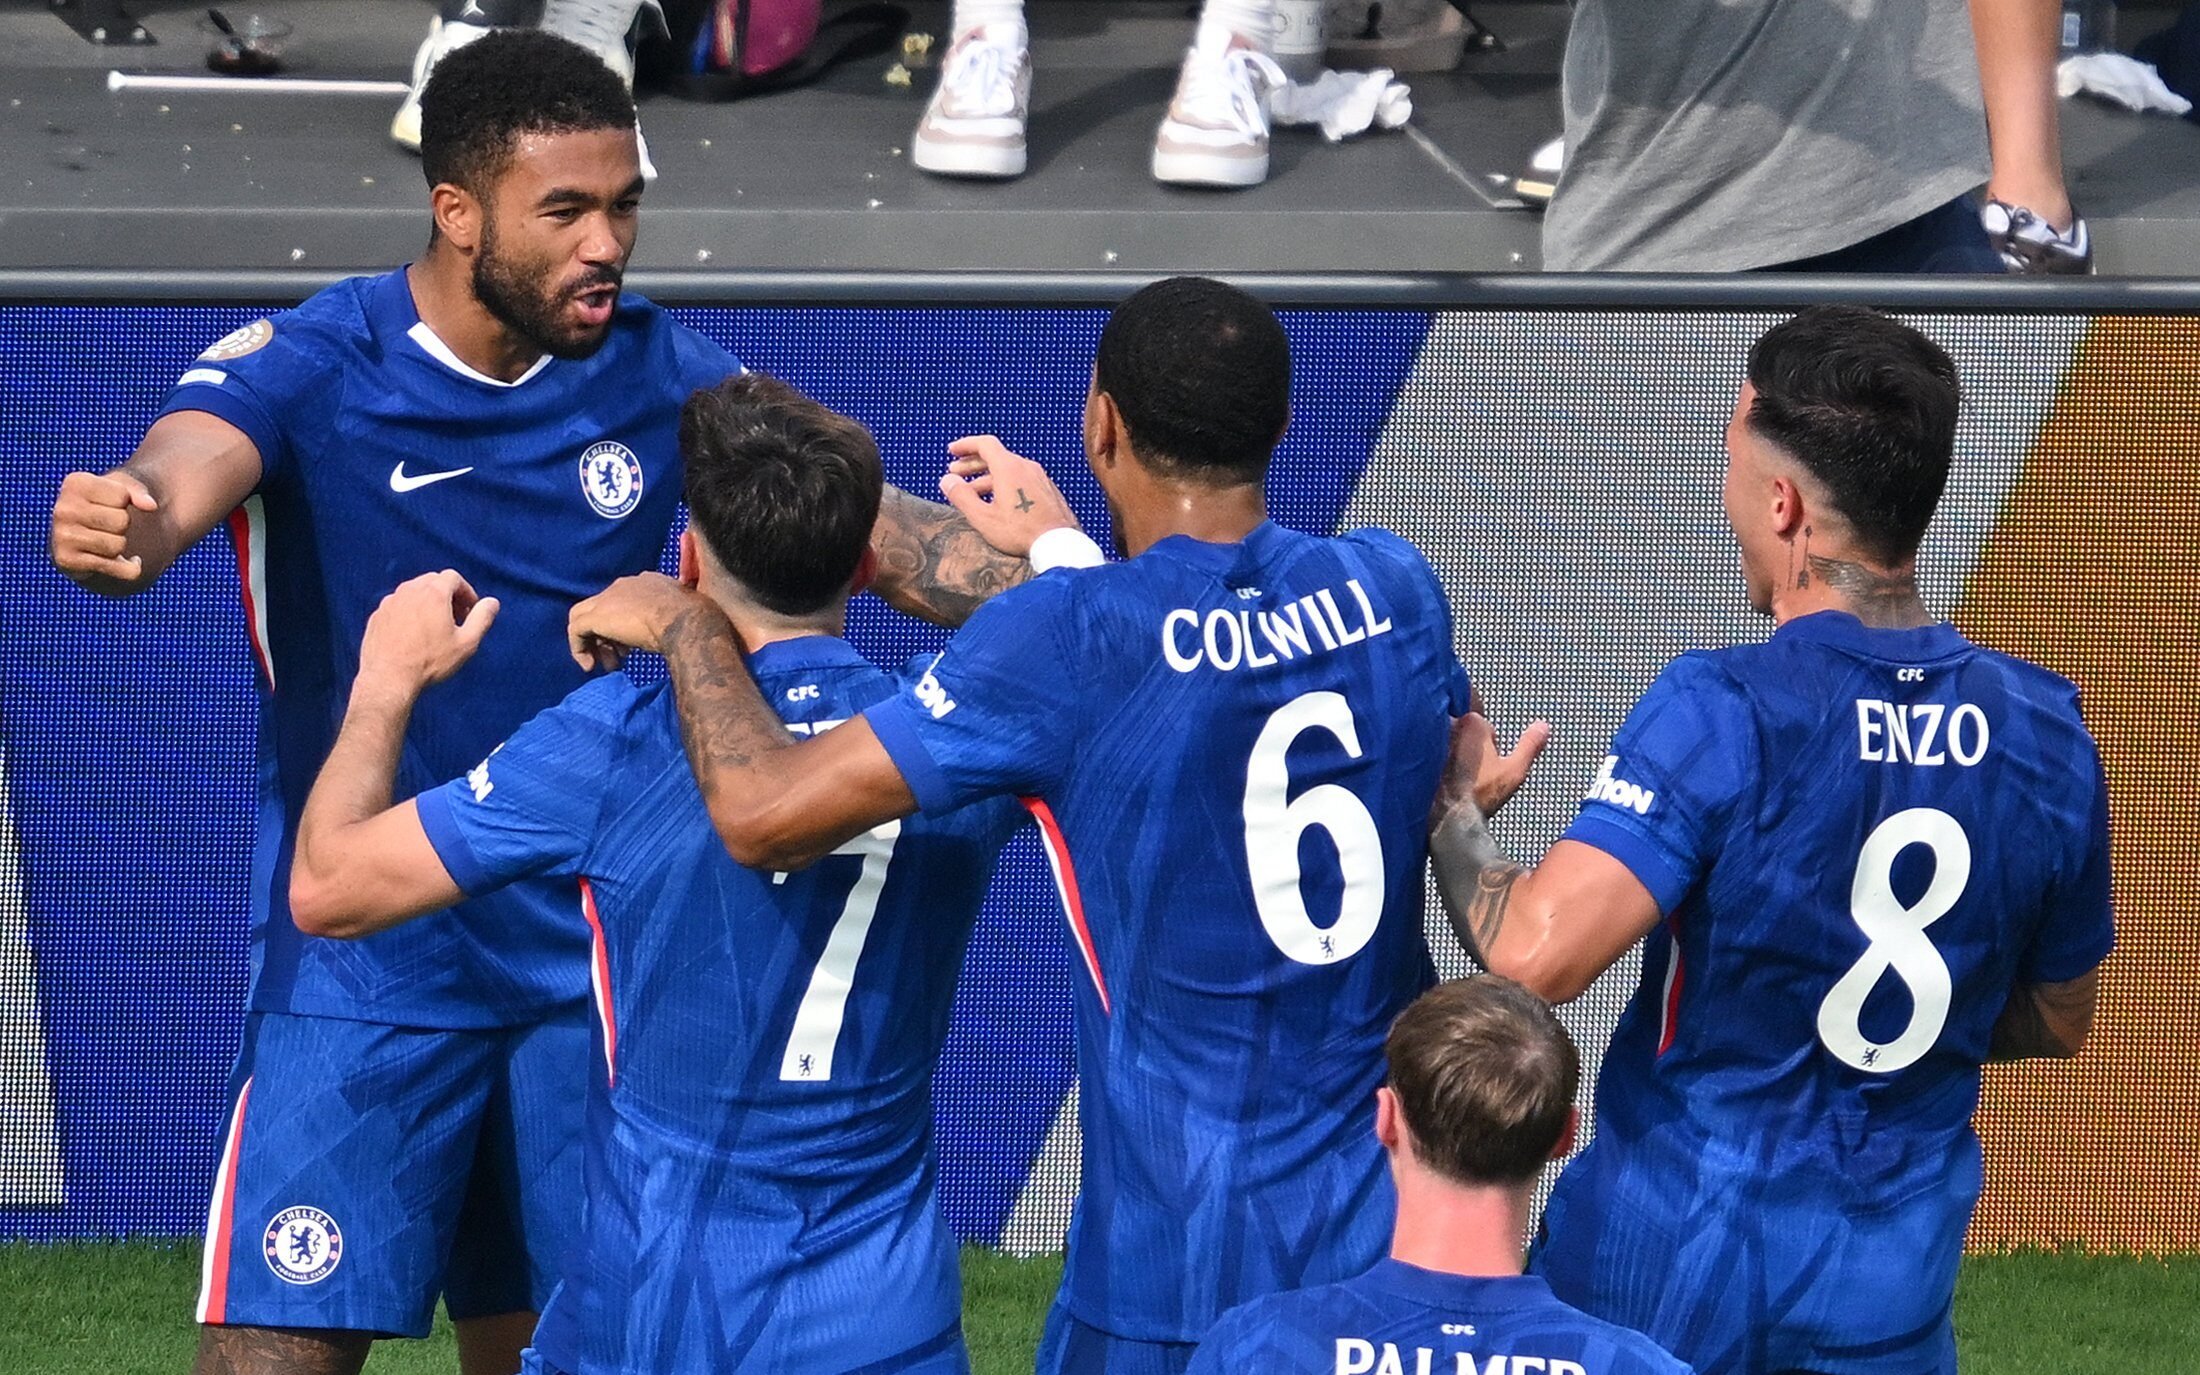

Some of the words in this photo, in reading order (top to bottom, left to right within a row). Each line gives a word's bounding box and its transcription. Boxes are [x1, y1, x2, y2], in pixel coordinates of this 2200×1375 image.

[586, 444, 628, 461] CHELSEA
[1162, 579, 1392, 673] COLWILL
[786, 684, 820, 702] CFC
[1897, 668, 1924, 682] CFC
[1856, 698, 1990, 767] ENZO
[1243, 690, 1385, 966] 6
[772, 818, 902, 1081] 7
[1817, 807, 1972, 1073] 8
[278, 1209, 329, 1228] CHELSEA
[1441, 1323, 1476, 1336] CFC
